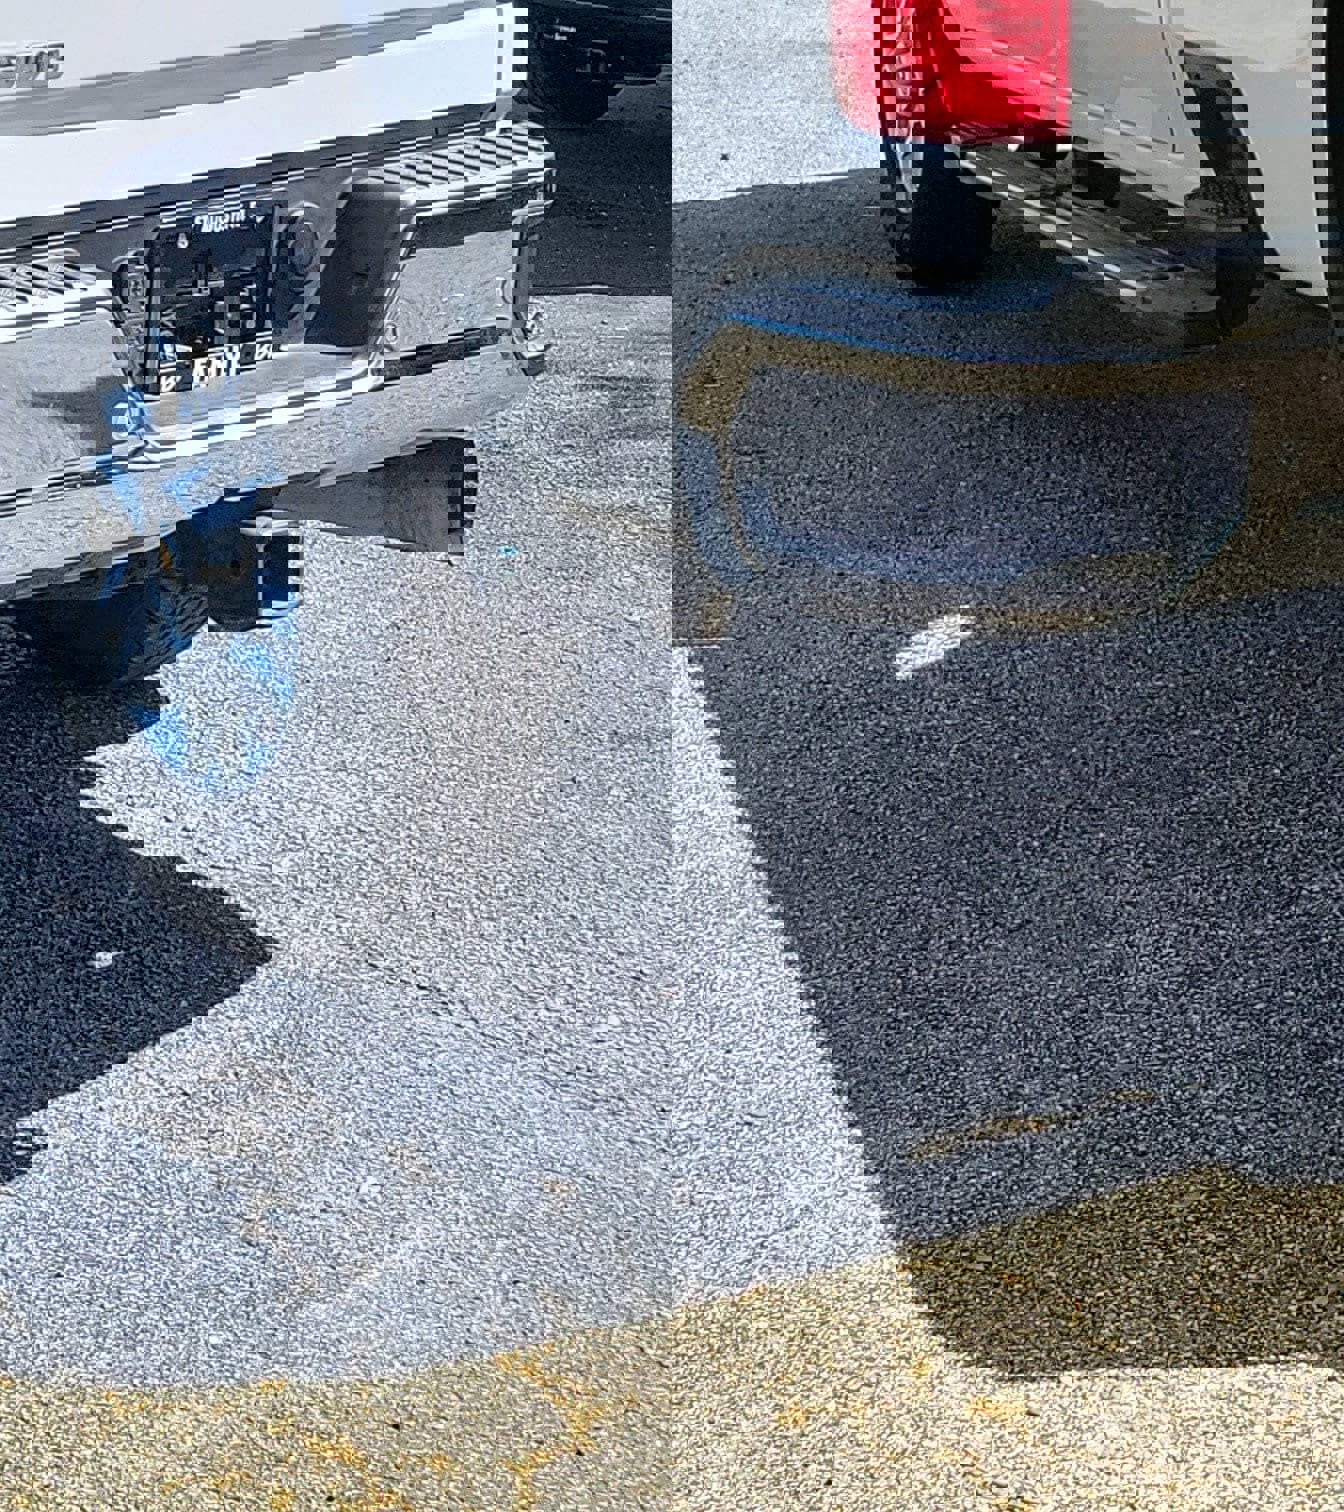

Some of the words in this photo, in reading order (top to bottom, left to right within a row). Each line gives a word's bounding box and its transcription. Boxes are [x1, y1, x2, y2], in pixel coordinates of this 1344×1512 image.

[1110, 26, 1165, 43] FAMILY
[1110, 44, 1127, 56] ST.
[1128, 39, 1193, 54] AUGUSTINE,
[1195, 37, 1207, 49] FL
[77, 215, 195, 275] GRABBER
[201, 252, 252, 313] H/T
